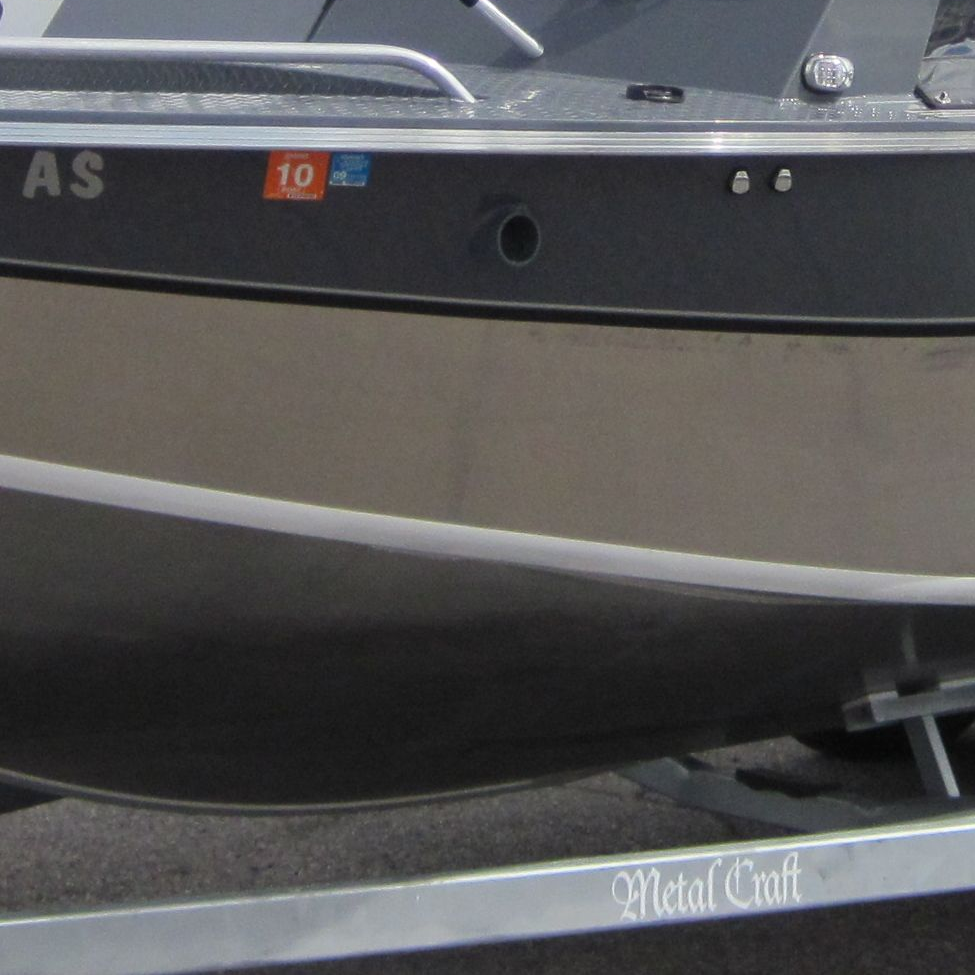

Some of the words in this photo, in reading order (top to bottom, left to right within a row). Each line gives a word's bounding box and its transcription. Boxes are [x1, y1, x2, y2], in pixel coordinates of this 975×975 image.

[22, 150, 104, 199] AS
[277, 163, 314, 187] 10
[612, 857, 722, 921] Metal
[725, 851, 802, 909] Craft
